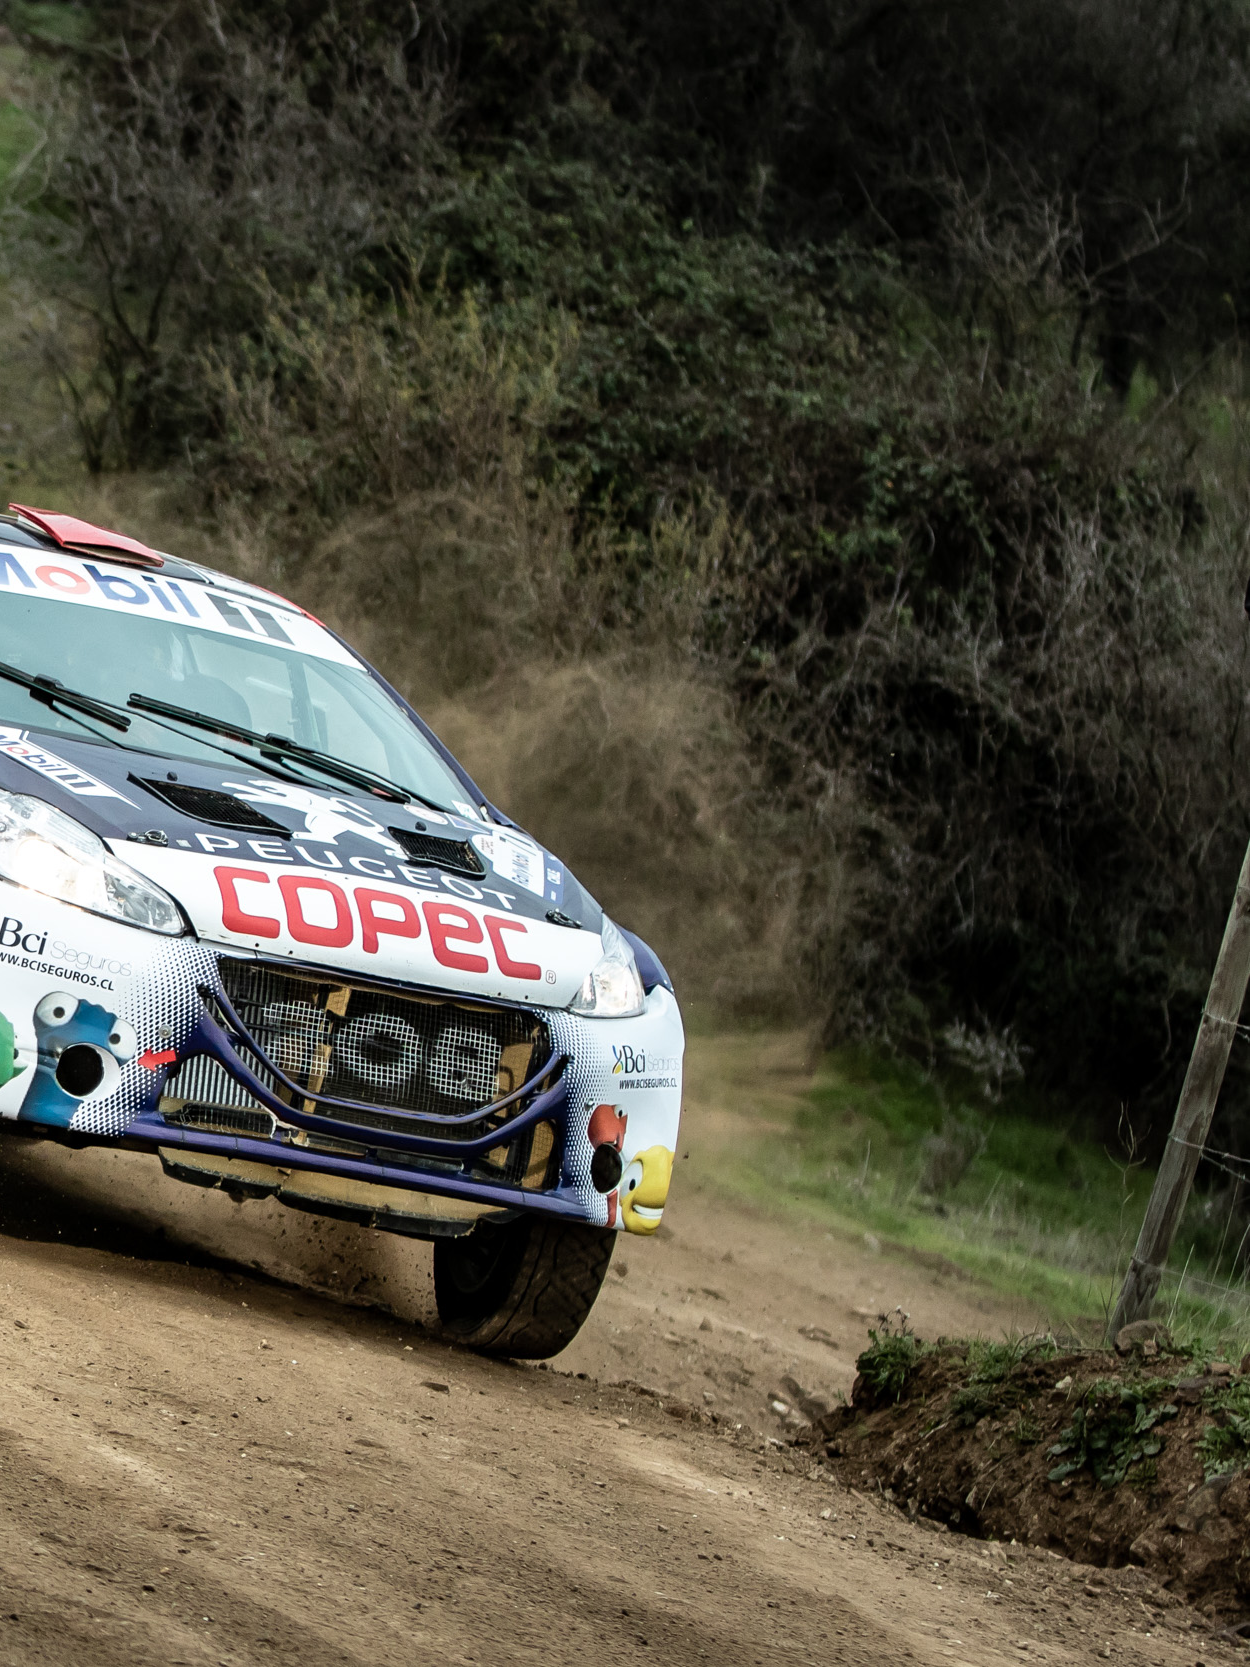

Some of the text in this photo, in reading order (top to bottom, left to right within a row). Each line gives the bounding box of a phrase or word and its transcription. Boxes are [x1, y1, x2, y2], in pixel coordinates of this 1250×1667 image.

[195, 832, 516, 909] PEUGEOT
[50, 940, 132, 977] Seguros
[622, 1045, 646, 1074] Bci
[619, 1077, 678, 1090] WWW.BCISEGUROS.CL
